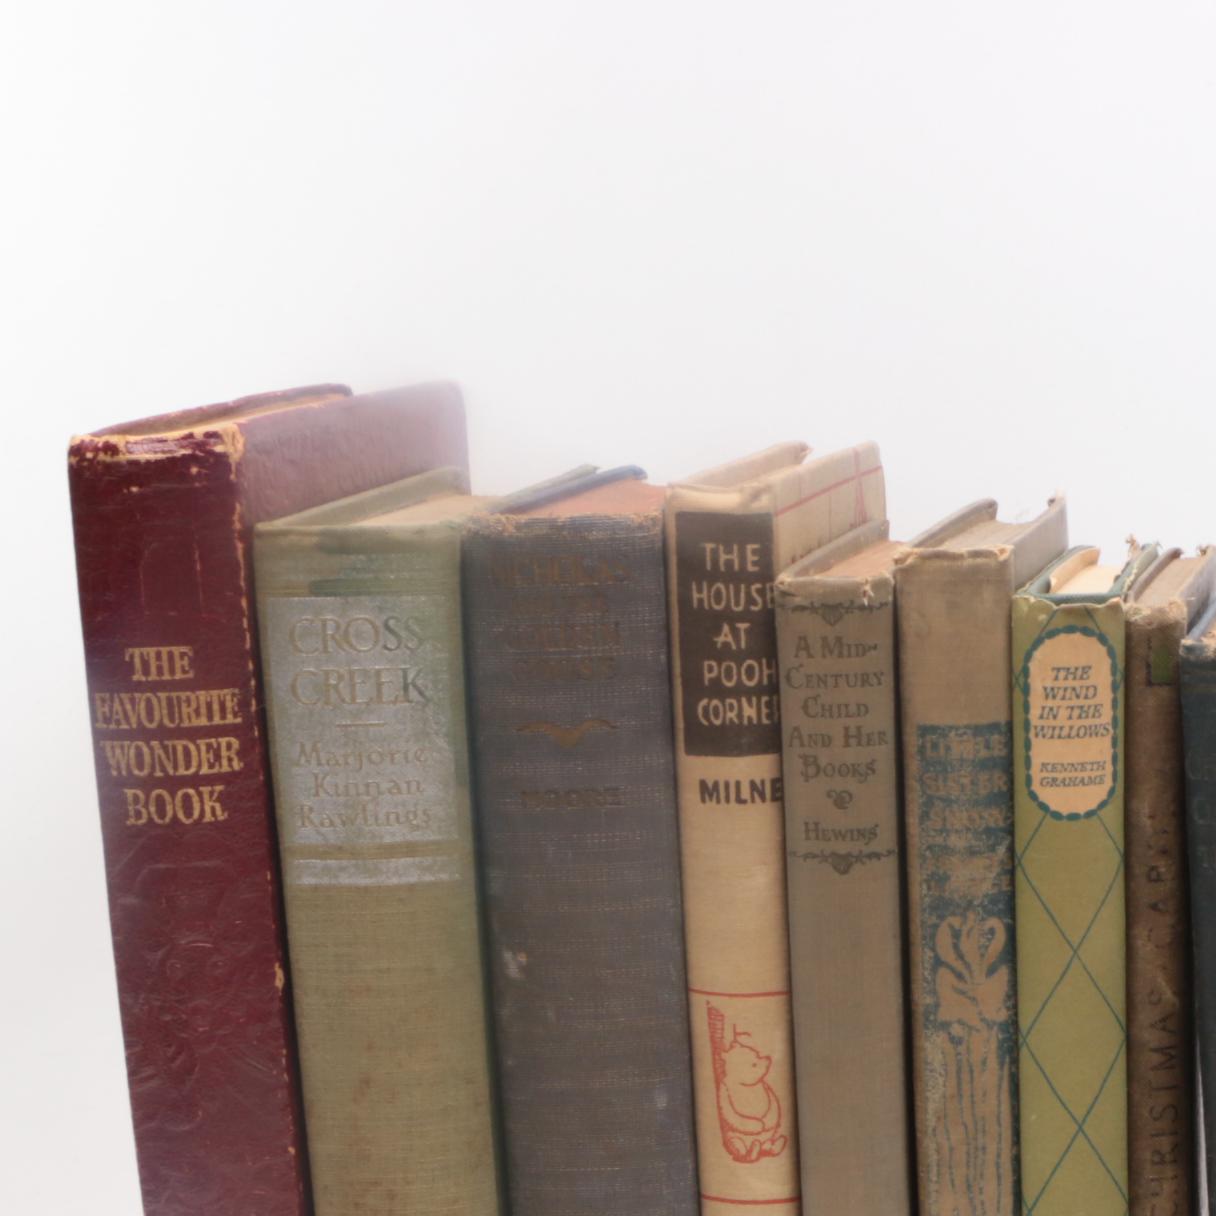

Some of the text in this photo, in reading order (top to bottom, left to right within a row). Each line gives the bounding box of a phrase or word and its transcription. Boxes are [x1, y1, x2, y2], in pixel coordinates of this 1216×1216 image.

[703, 543, 760, 572] THE
[288, 616, 426, 656] CROSS
[713, 622, 751, 650] AT
[793, 637, 815, 658] A
[124, 646, 194, 680] THE
[1051, 665, 1092, 682] THE
[290, 666, 429, 709] CREEK
[1041, 685, 1098, 701] WIND
[95, 688, 243, 730] FAVOURITE
[697, 696, 779, 726] CORNE
[1038, 703, 1104, 720] IN THE
[1032, 723, 1111, 739] WILLOWS
[101, 737, 244, 778] WONDER
[296, 742, 430, 772] Marjorie
[1039, 760, 1107, 774] KENNETH
[313, 774, 424, 798] Kinnan
[699, 779, 783, 805] MILNE
[1039, 774, 1106, 788] GRAHAME
[124, 785, 228, 826] BOOK
[298, 803, 432, 832] Rawlings
